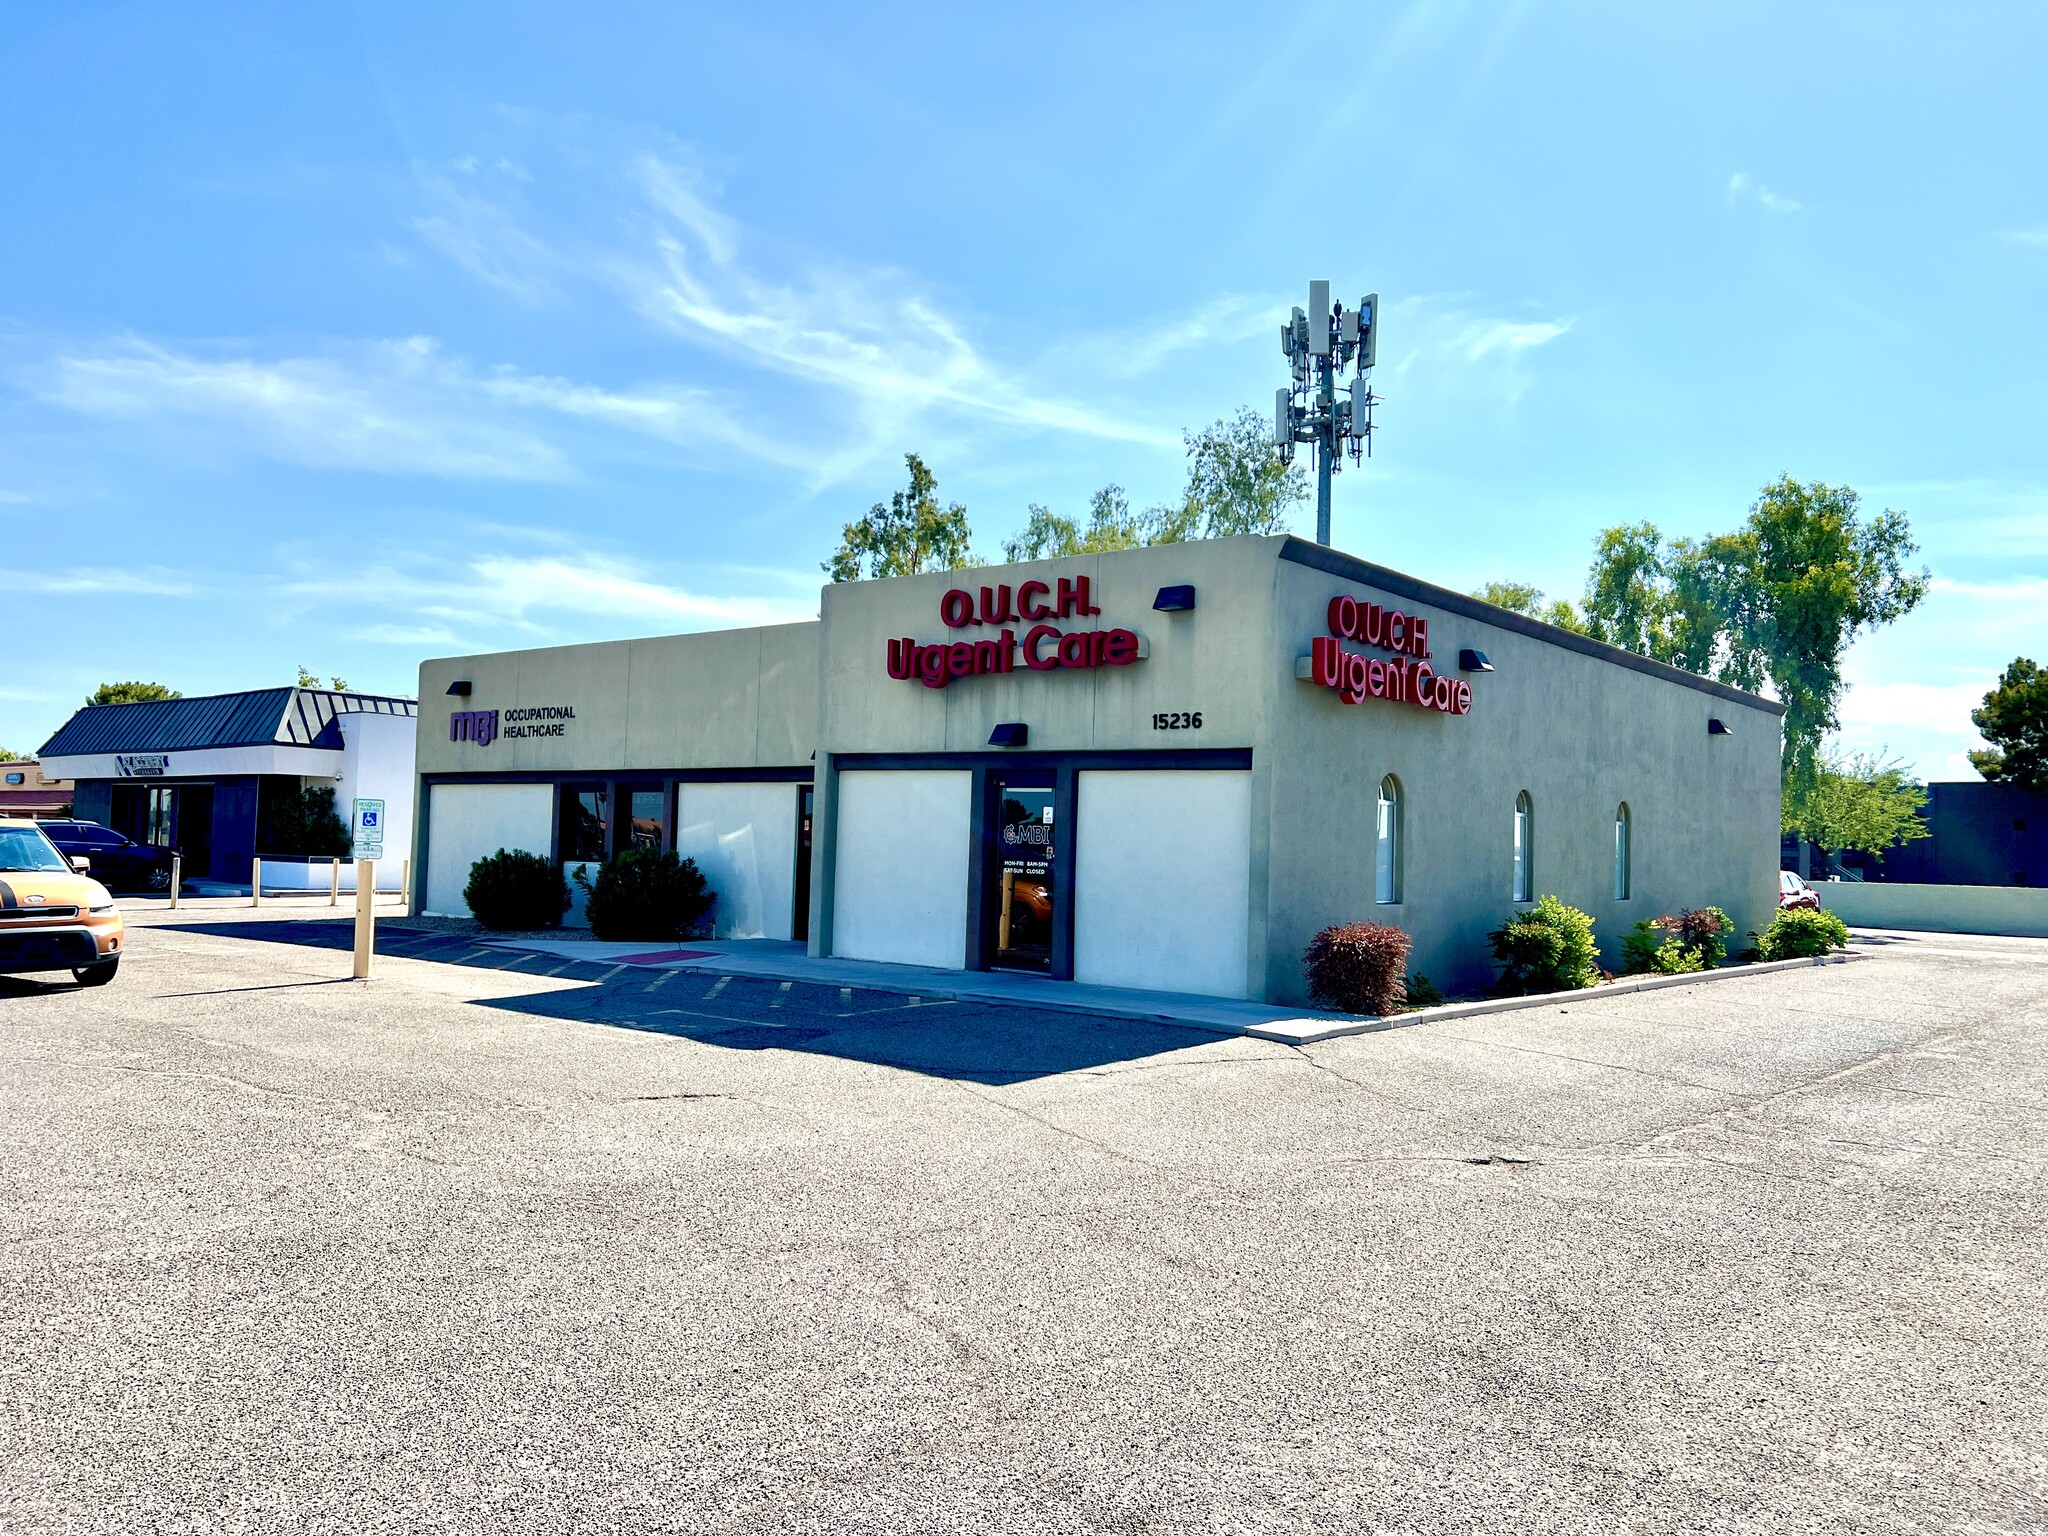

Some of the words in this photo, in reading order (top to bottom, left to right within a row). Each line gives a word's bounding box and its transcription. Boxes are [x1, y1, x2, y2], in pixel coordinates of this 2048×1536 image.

[940, 575, 1101, 628] O.U.C.H.
[1327, 594, 1433, 659] O.U.C.H.
[887, 628, 1017, 689] Urgent
[1023, 624, 1140, 671] Care
[1312, 636, 1408, 705] Urgent
[1409, 661, 1473, 715] Care
[503, 724, 565, 739] HEALTHCARE
[504, 706, 576, 722] OCCUPATIONAL
[1152, 712, 1203, 730] 15236
[1017, 825, 1050, 844] MBI
